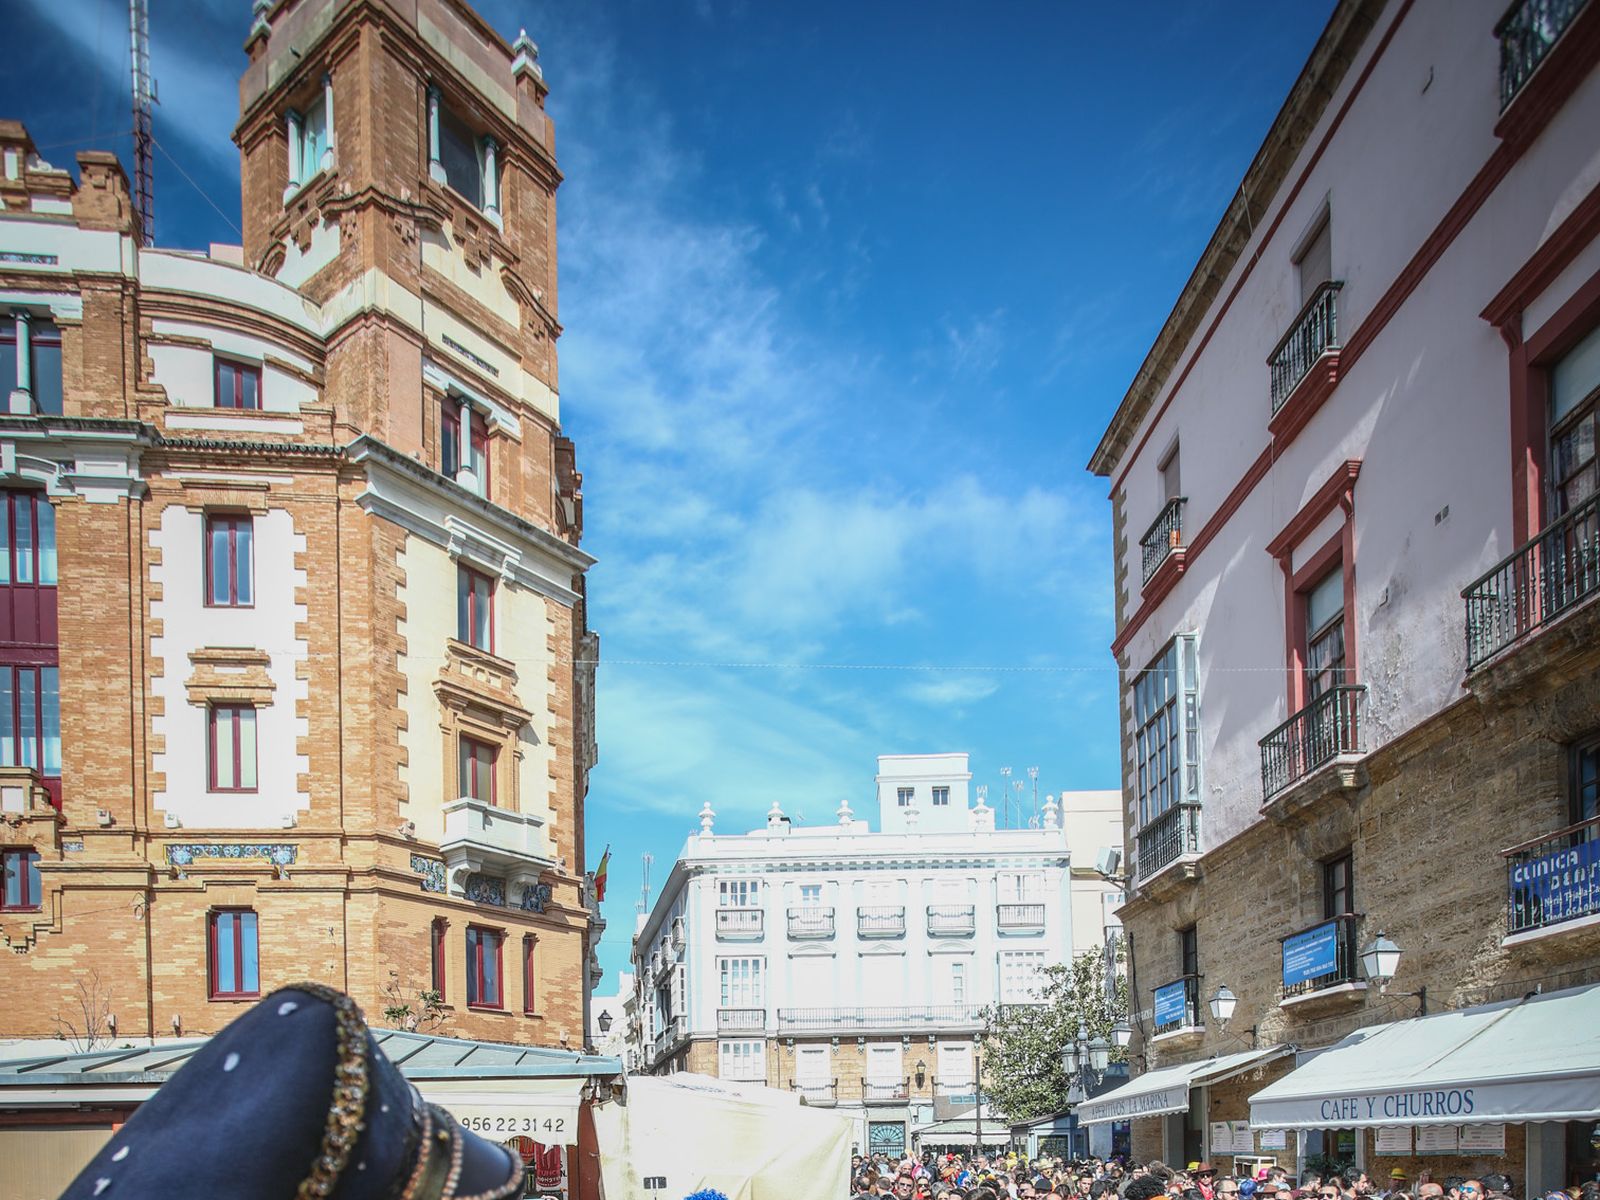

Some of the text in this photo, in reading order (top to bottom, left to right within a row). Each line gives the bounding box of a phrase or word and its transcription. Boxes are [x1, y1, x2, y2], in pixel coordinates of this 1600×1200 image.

[1551, 860, 1600, 890] DENT
[1092, 1092, 1168, 1119] APERITIVOS LA MARINA
[1321, 1089, 1474, 1120] CAFE Y CHURROS
[461, 1117, 565, 1132] 956 22 31 42
